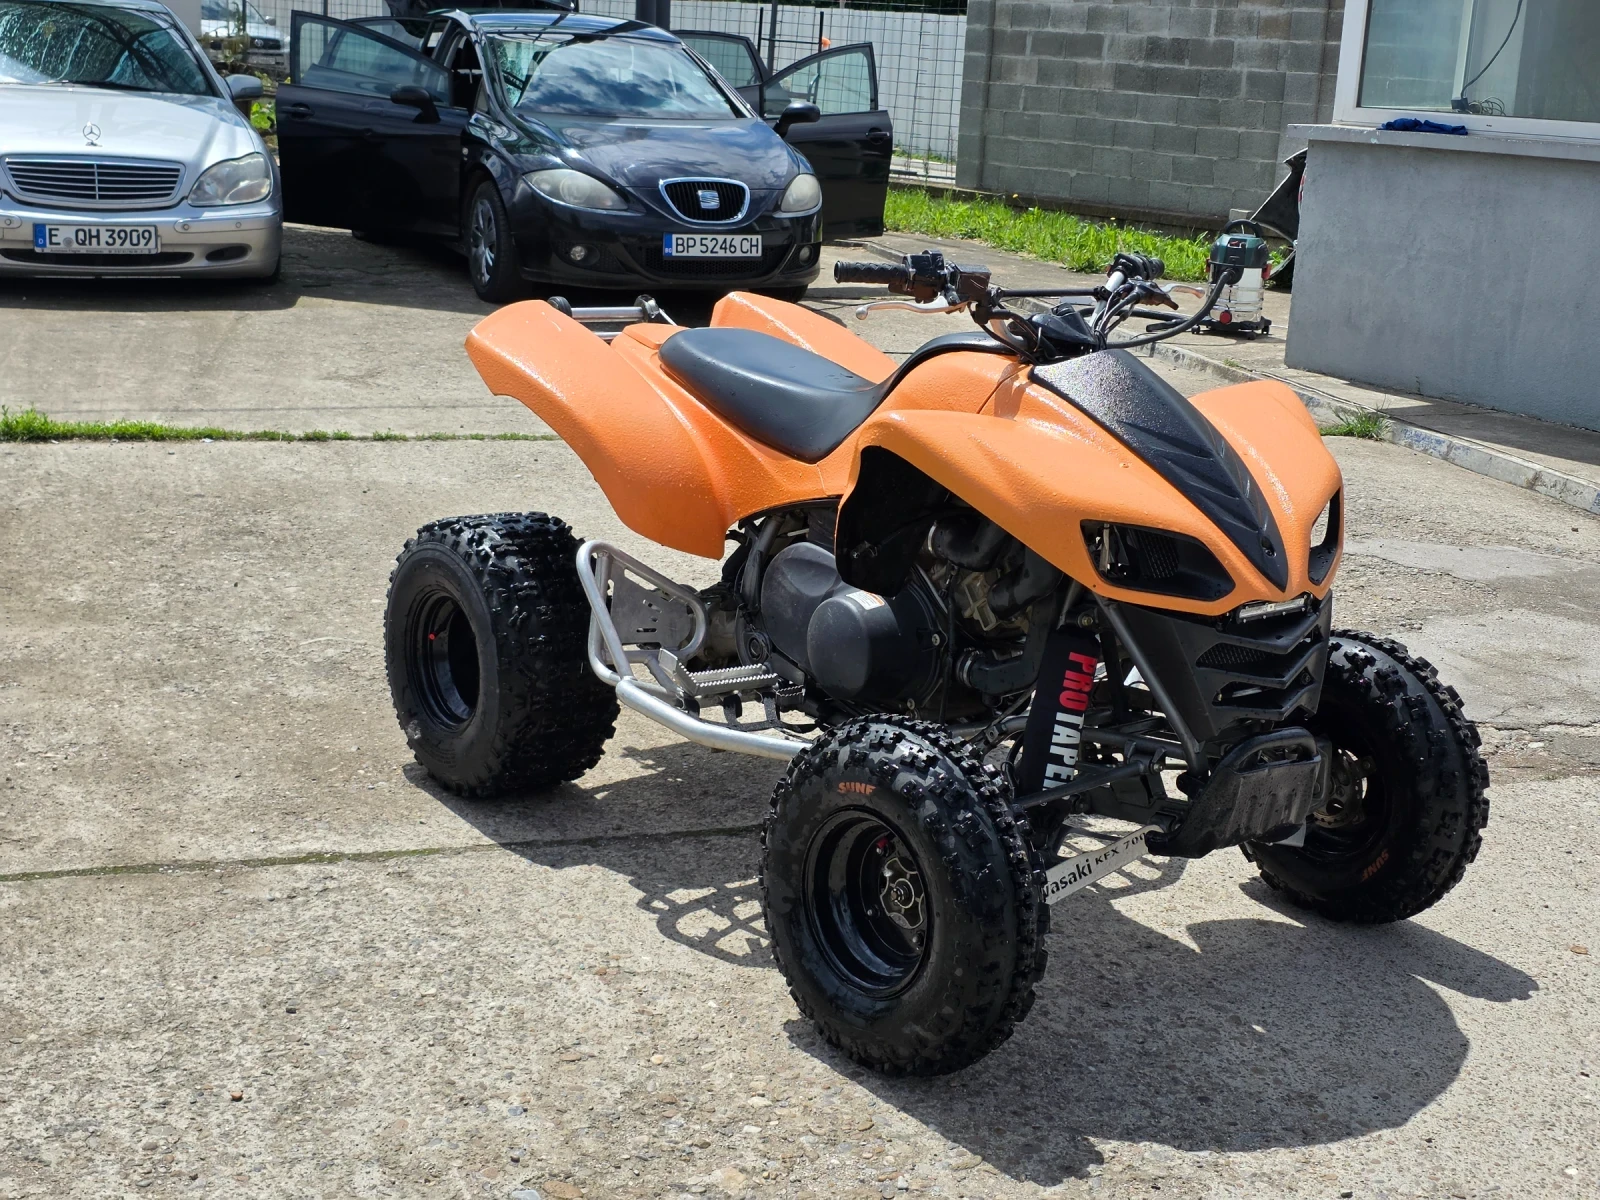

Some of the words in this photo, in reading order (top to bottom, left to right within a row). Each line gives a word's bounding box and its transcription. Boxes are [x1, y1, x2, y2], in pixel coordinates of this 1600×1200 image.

[48, 227, 61, 246] E
[75, 228, 100, 247] QH
[105, 228, 152, 247] 3909
[675, 237, 696, 254] BP
[700, 237, 737, 254] 5246
[740, 237, 759, 254] CH
[837, 782, 877, 795] SUNF
[1095, 847, 1120, 866] KFX
